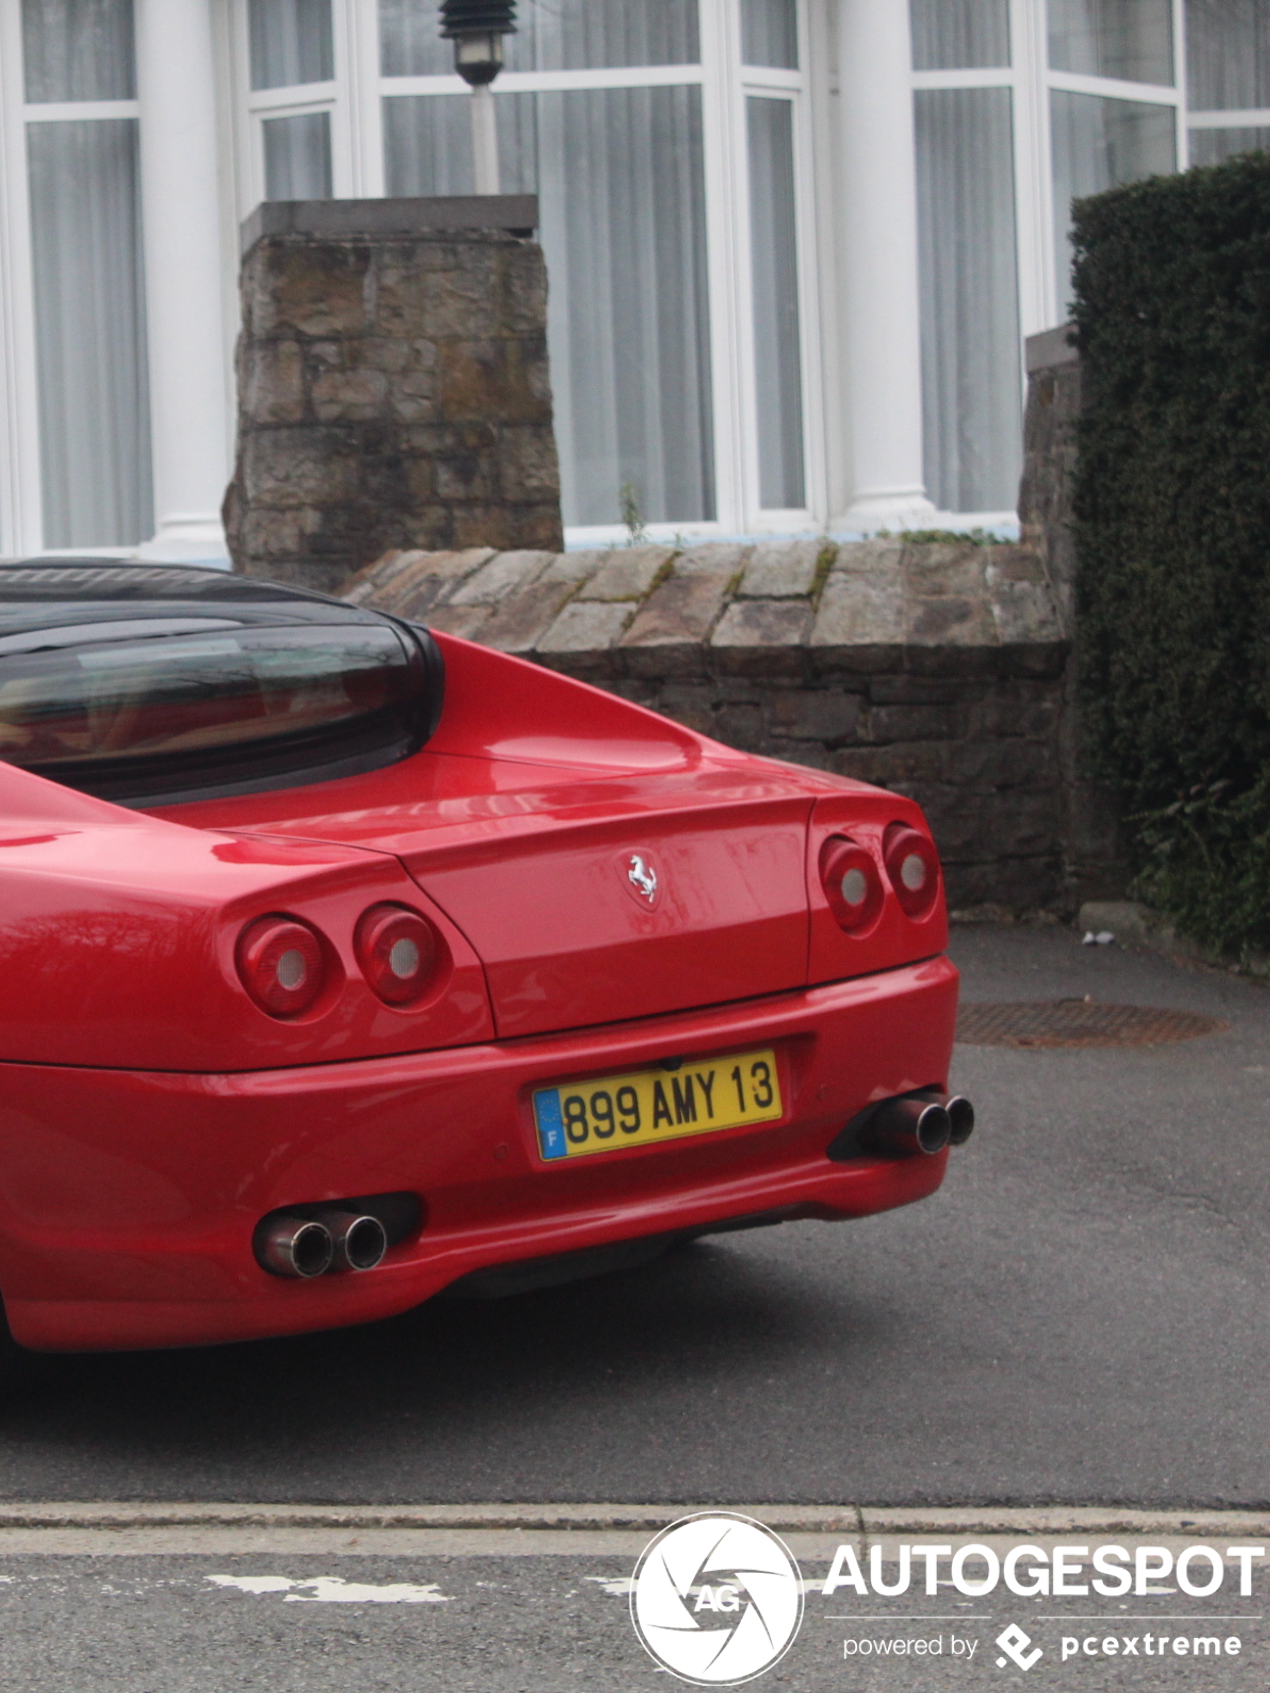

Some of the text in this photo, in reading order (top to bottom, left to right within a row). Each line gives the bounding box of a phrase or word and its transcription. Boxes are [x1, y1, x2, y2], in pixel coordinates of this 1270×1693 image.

[563, 1061, 774, 1144] 899 AMY 13
[547, 1131, 558, 1147] F
